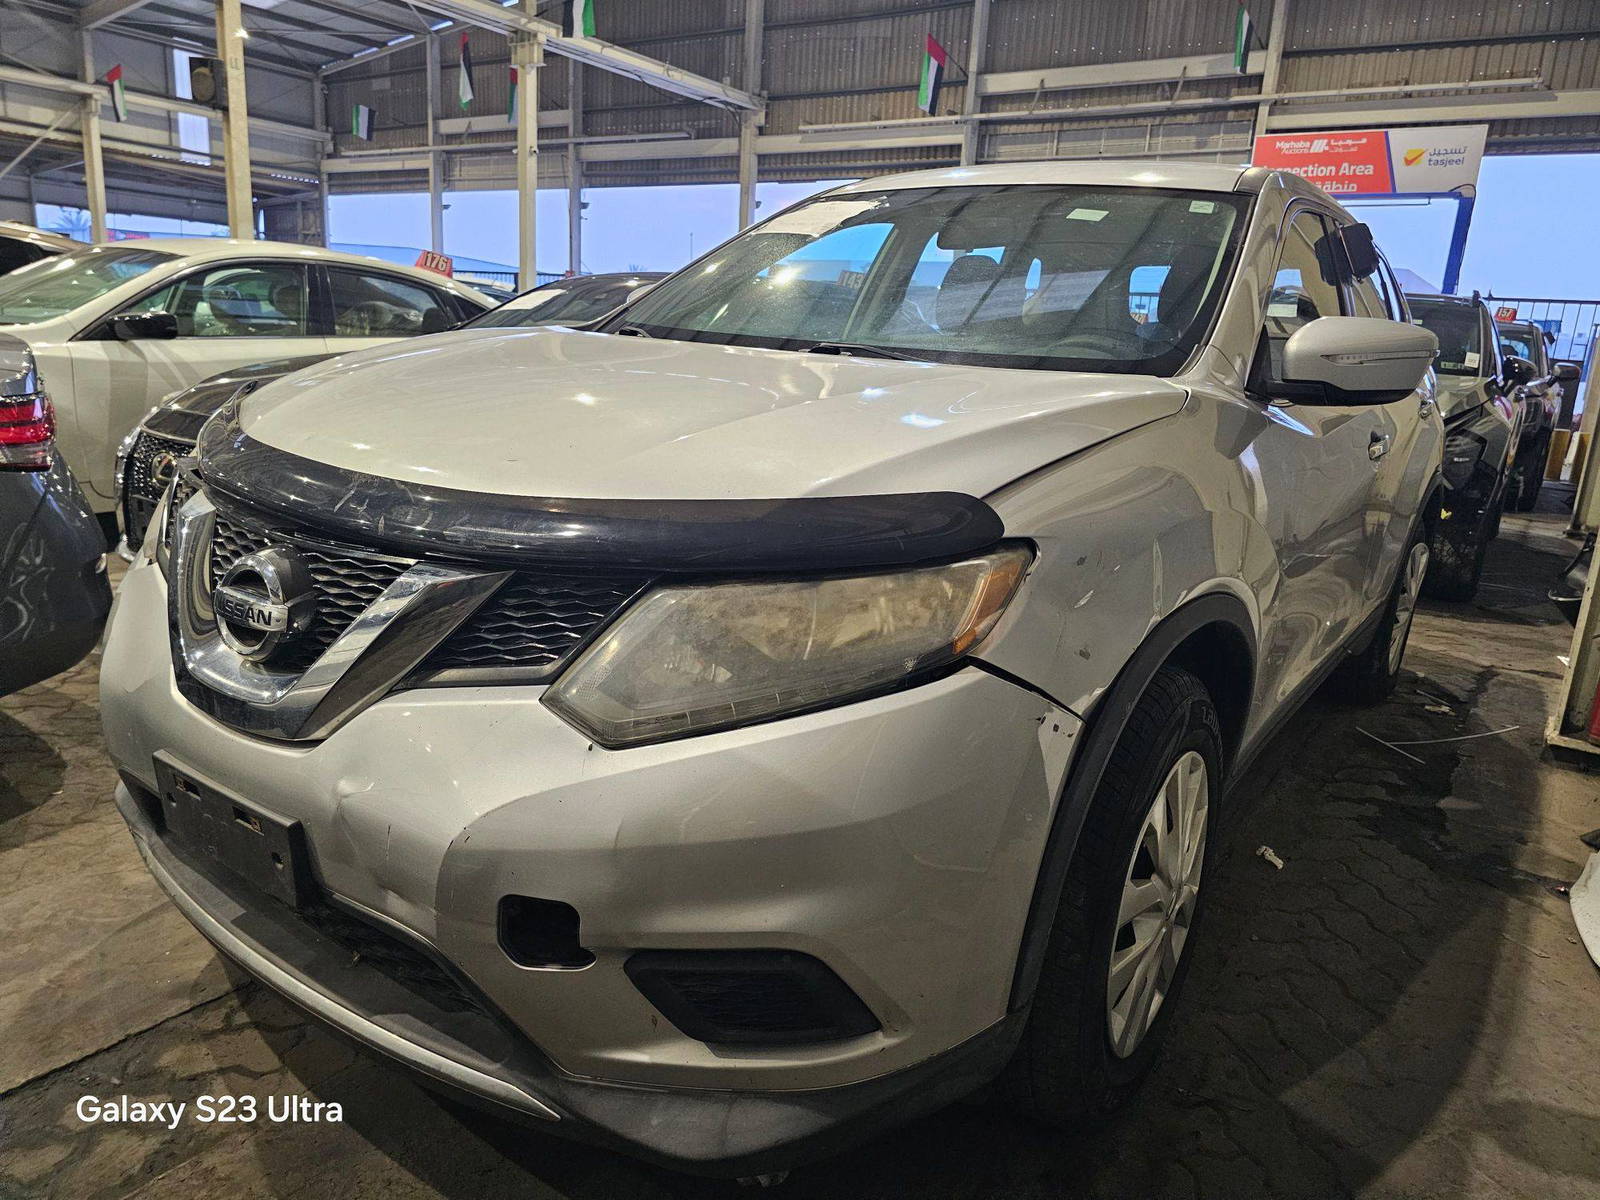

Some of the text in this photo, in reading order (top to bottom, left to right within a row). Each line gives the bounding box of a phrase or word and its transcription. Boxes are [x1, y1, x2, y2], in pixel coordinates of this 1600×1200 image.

[1275, 141, 1311, 150] Marhaba
[1429, 146, 1468, 156] تسجيل
[1428, 156, 1465, 168] tasjeel
[1338, 162, 1374, 176] Area
[425, 252, 448, 272] 176
[1499, 307, 1513, 318] 157
[216, 590, 273, 626] NISSAN
